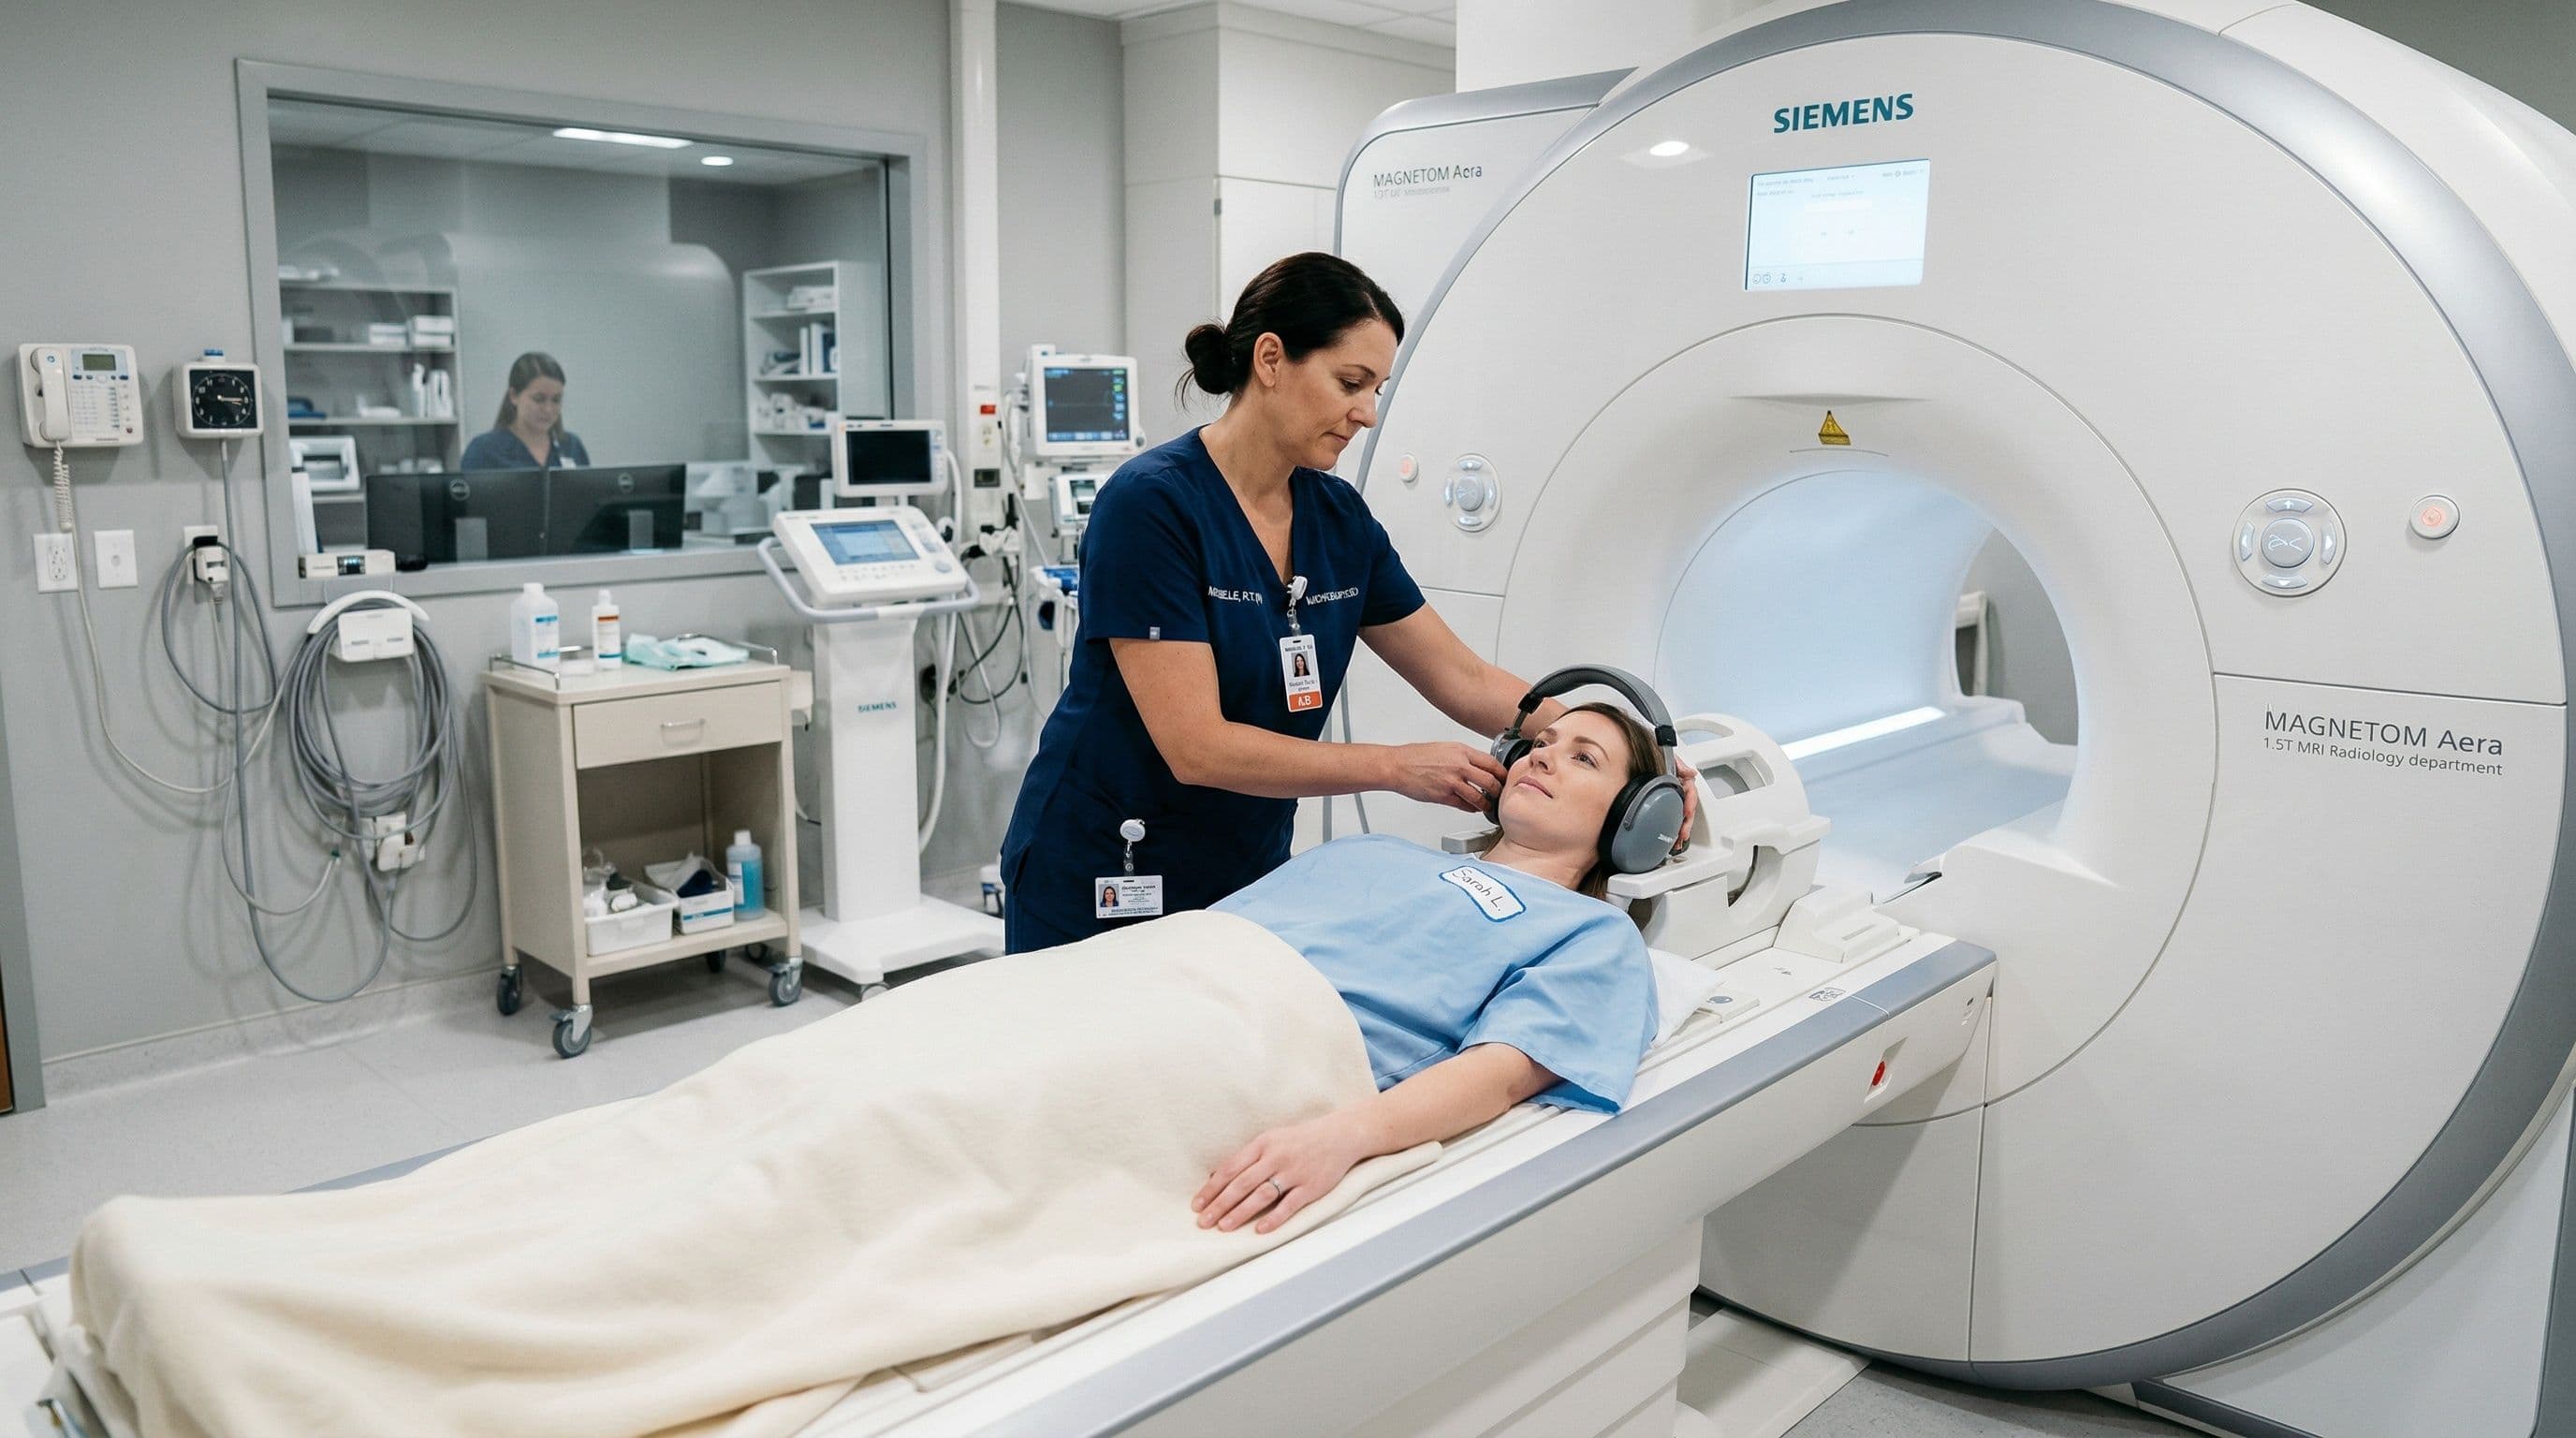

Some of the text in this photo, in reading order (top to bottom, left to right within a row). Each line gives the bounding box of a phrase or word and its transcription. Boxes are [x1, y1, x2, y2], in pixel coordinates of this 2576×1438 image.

[1774, 93, 1914, 134] SIEMENS
[1373, 167, 1450, 188] MAGNETOM
[2264, 710, 2503, 756] MAGNETOM Aera
[2263, 737, 2503, 776] 1.5T MRI Radiology department
[1452, 868, 1504, 912] Sarah L.
